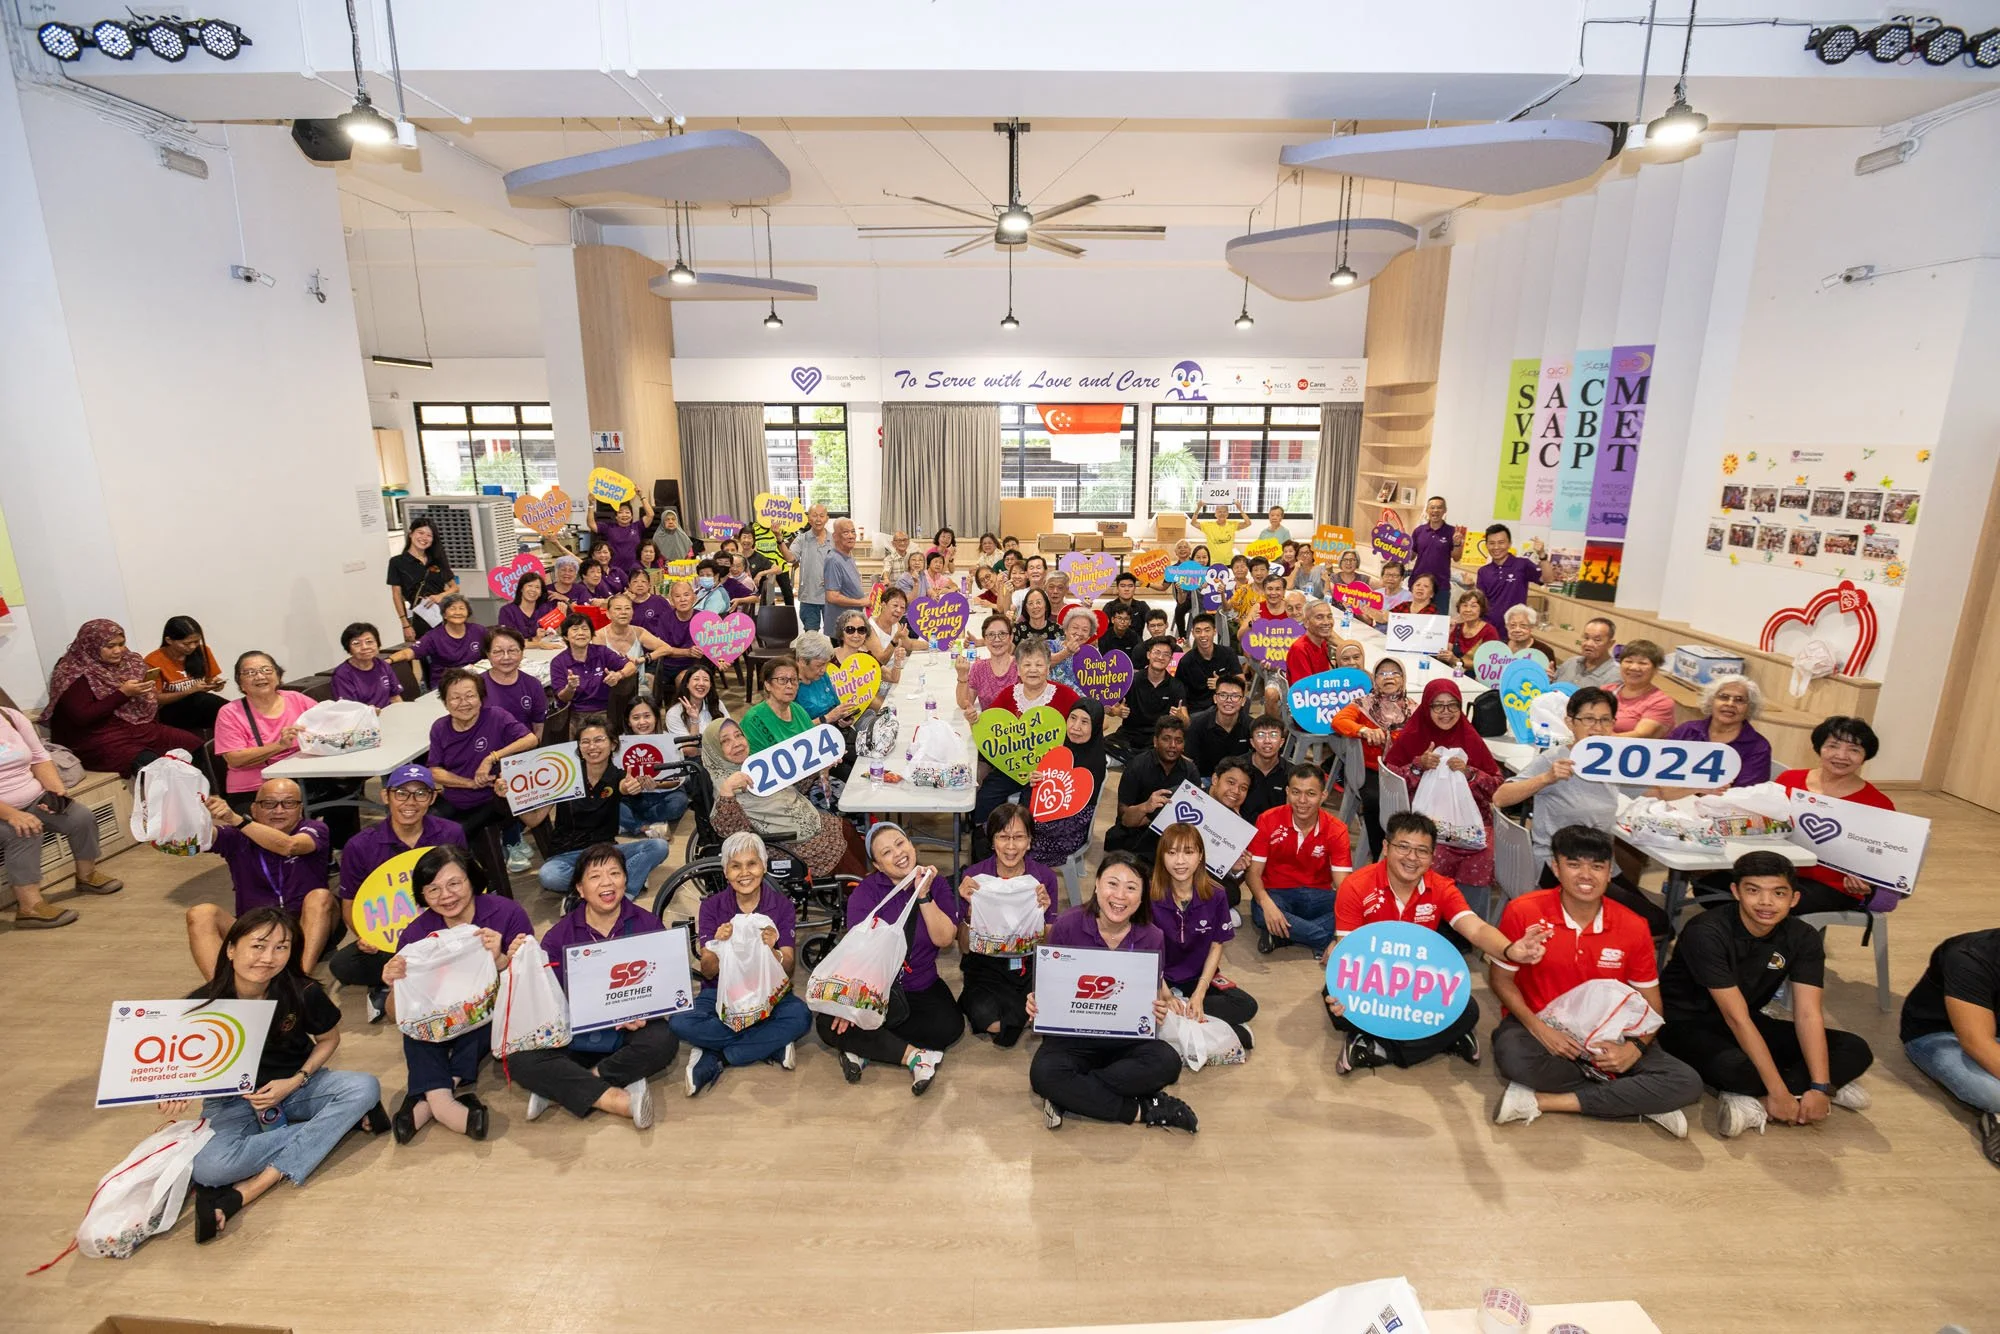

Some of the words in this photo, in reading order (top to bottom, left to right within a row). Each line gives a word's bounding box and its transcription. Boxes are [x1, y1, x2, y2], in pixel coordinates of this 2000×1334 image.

[894, 370, 917, 390] To
[925, 371, 976, 388] Serve
[983, 370, 1021, 388] with
[1028, 370, 1072, 388] Love
[1078, 370, 1120, 388] and
[1116, 371, 1160, 390] Care
[592, 486, 624, 501] Senior
[595, 478, 627, 496] Happy
[522, 501, 567, 526] Volunteer
[766, 498, 792, 511] Kaki!
[704, 520, 742, 529] Volunteering
[761, 508, 803, 523] Blossom
[714, 528, 734, 537] FUN!
[1248, 546, 1278, 557] Blossom
[1374, 539, 1408, 560] Grateful
[494, 561, 532, 584] Tender
[1134, 554, 1170, 576] Blossom
[1067, 566, 1114, 586] Volunteer
[1178, 576, 1202, 586] FUN!
[1088, 582, 1108, 592] Cool
[1336, 586, 1381, 602] Volunteering
[916, 600, 961, 618] Tender
[702, 620, 730, 633] Being
[916, 614, 962, 631] Loving
[1271, 627, 1284, 635] am
[695, 628, 752, 648] Volunteer
[922, 626, 958, 640] Care
[722, 642, 745, 658] Cool
[829, 668, 848, 682] eing
[850, 658, 860, 673] A
[1084, 658, 1106, 673] Being
[1108, 654, 1117, 668] A
[1076, 670, 1128, 688] Volunteer
[1316, 678, 1320, 688] I
[1323, 680, 1340, 688] am
[1344, 679, 1350, 688] a
[1090, 689, 1100, 700] Is
[1101, 688, 1121, 700] Cool
[1292, 688, 1366, 710] Blossom
[990, 722, 1026, 739] Being
[1030, 712, 1042, 728] A
[982, 728, 1060, 758] Volunteer
[748, 728, 839, 793] 2024
[1005, 758, 1020, 772] Is
[1582, 742, 1726, 783] 2024
[510, 767, 550, 793] aic
[1042, 768, 1075, 810] Healthier
[1040, 788, 1057, 809] SG
[1203, 824, 1222, 840] Blossom
[1222, 838, 1236, 850] Seeds
[1847, 832, 1881, 846] Blossom
[1882, 841, 1908, 853] Seeds
[386, 873, 392, 886] I
[1370, 936, 1376, 952] I
[1381, 940, 1410, 957] am
[1416, 946, 1428, 960] a
[1336, 957, 1461, 1006] HAPPY
[606, 986, 652, 1000] TOGETHER
[1070, 1002, 1118, 1011] TOGETHER
[1348, 994, 1445, 1026] Volunteer
[134, 1034, 206, 1064] aic
[130, 1072, 176, 1083] integrated
[178, 1072, 196, 1080] care
[131, 1066, 164, 1076] agency
